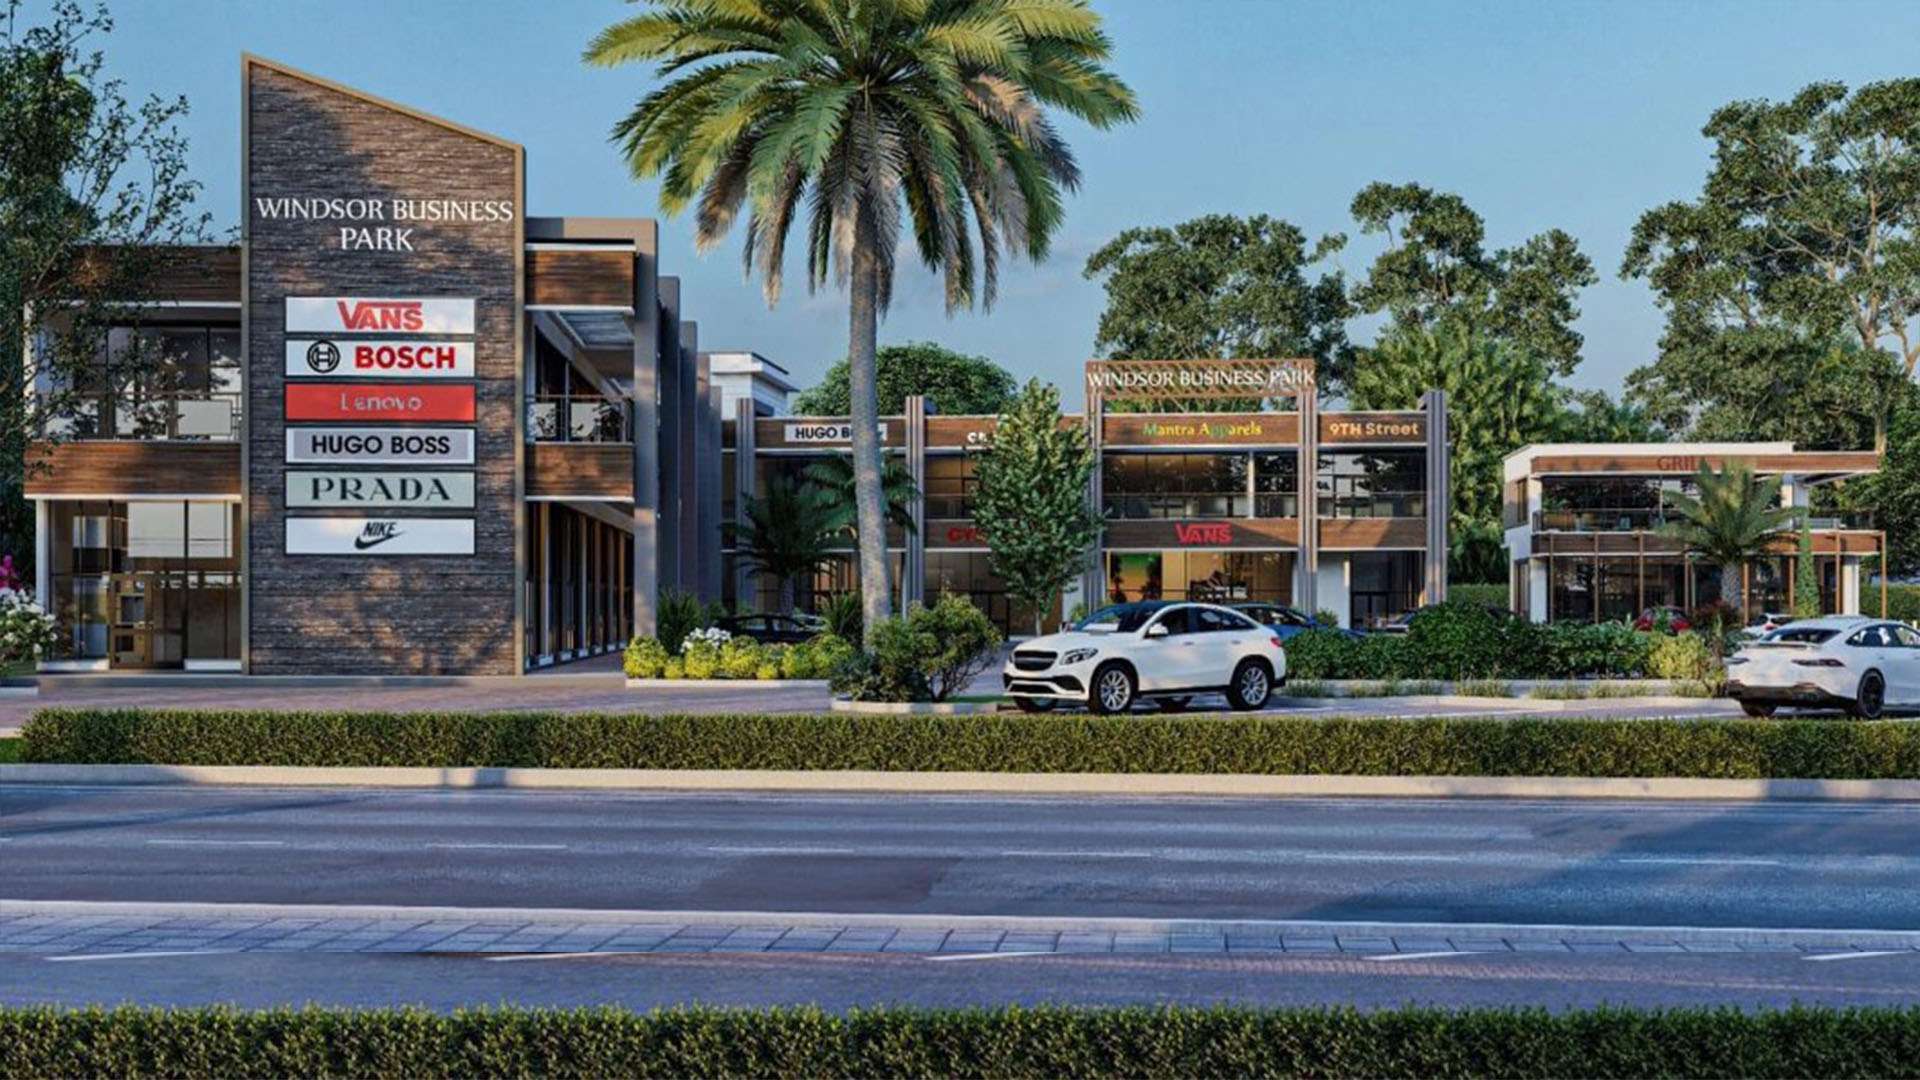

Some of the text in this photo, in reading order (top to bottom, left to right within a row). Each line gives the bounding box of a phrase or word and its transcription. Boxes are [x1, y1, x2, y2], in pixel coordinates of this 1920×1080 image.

[256, 198, 514, 222] WINDSOR BUSINESS
[340, 227, 414, 251] PARK
[337, 301, 424, 330] VANS
[355, 345, 455, 369] BOSCH
[1087, 369, 1315, 387] WINDSOR BUSINESS PARK
[340, 392, 422, 411] Lenovo
[795, 426, 838, 439] HUGO
[1143, 421, 1263, 438] Mantra Apparels
[1329, 422, 1419, 436] 9TH Street
[311, 435, 450, 454] HUGO BOSS
[312, 477, 451, 501] PRADA
[362, 521, 397, 536] NIKE
[1175, 522, 1233, 544] VANS
